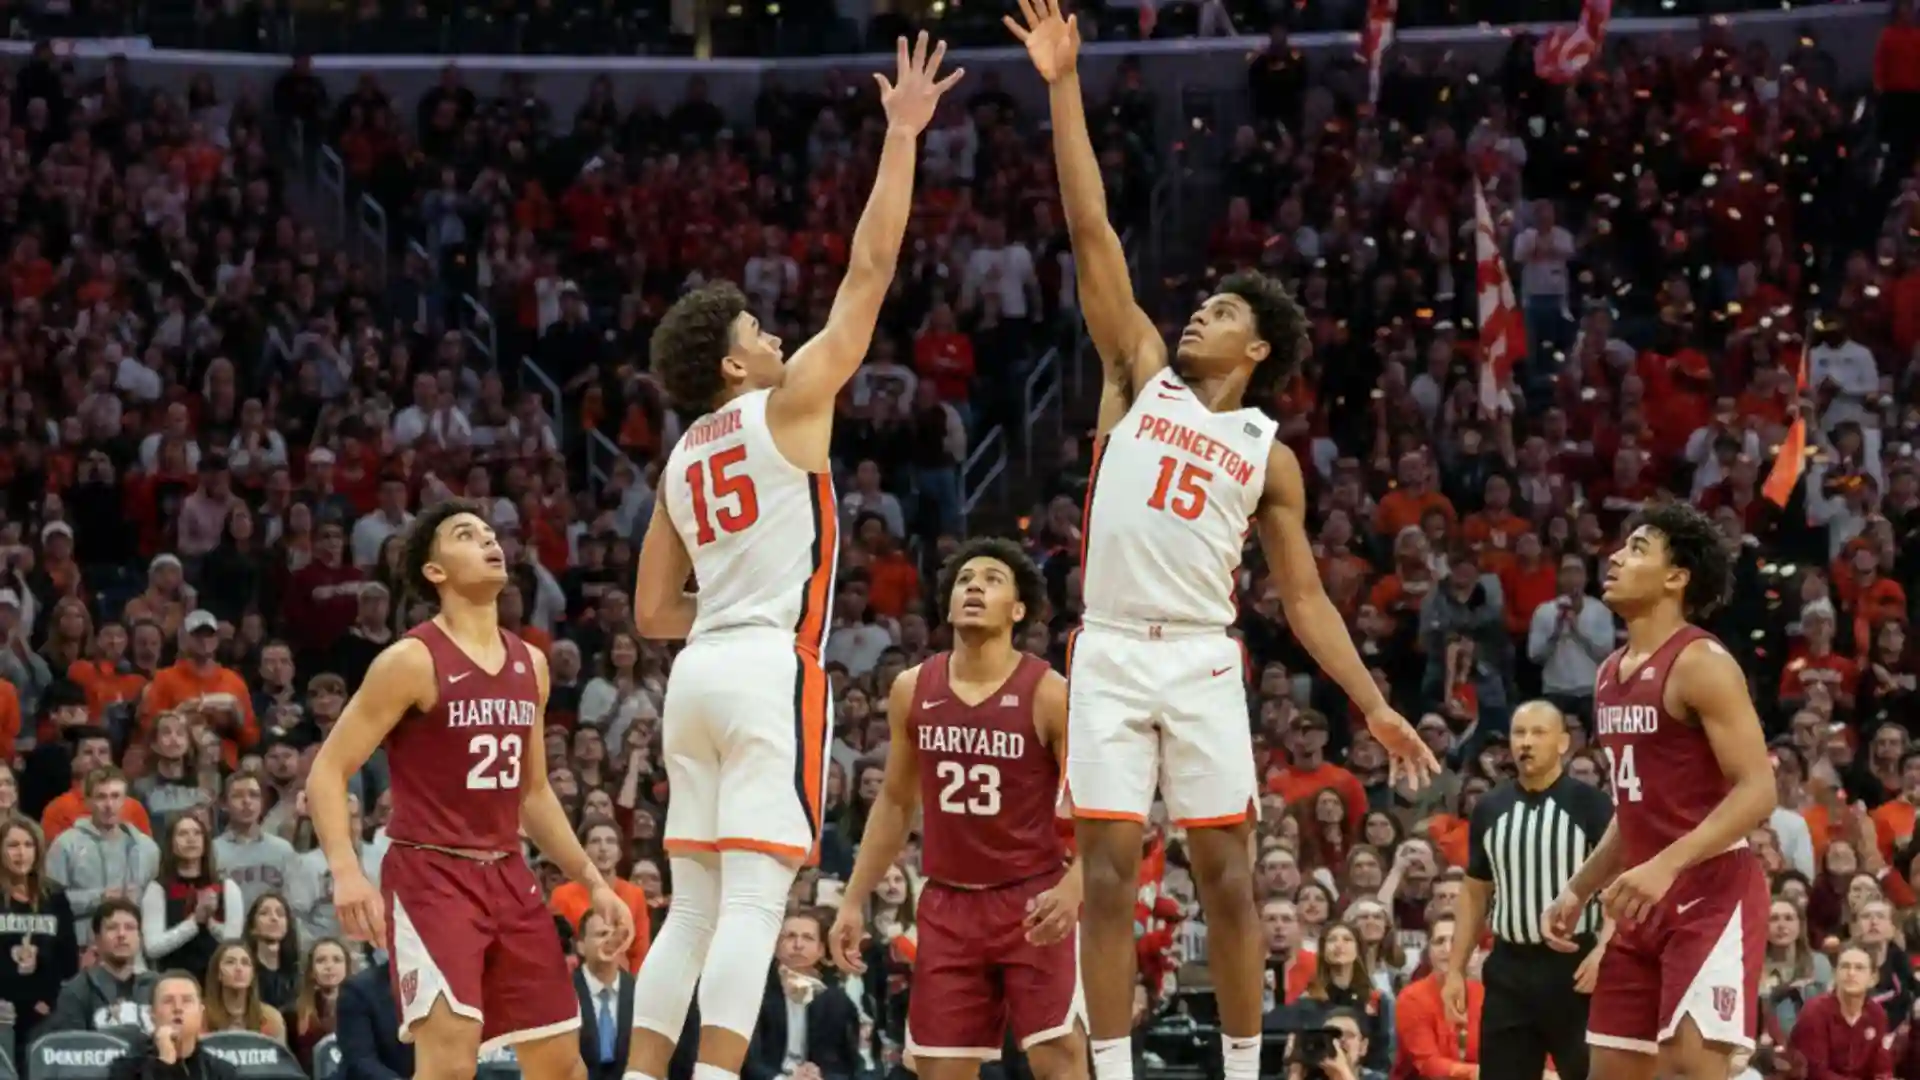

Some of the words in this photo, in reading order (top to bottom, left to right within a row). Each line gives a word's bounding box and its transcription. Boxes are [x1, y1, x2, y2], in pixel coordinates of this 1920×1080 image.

[1134, 414, 1255, 487] PRINCETON
[686, 444, 759, 546] 15
[1146, 456, 1214, 520] 15
[466, 733, 522, 789] 23
[918, 725, 1025, 759] HARVARD
[936, 761, 1001, 816] 23
